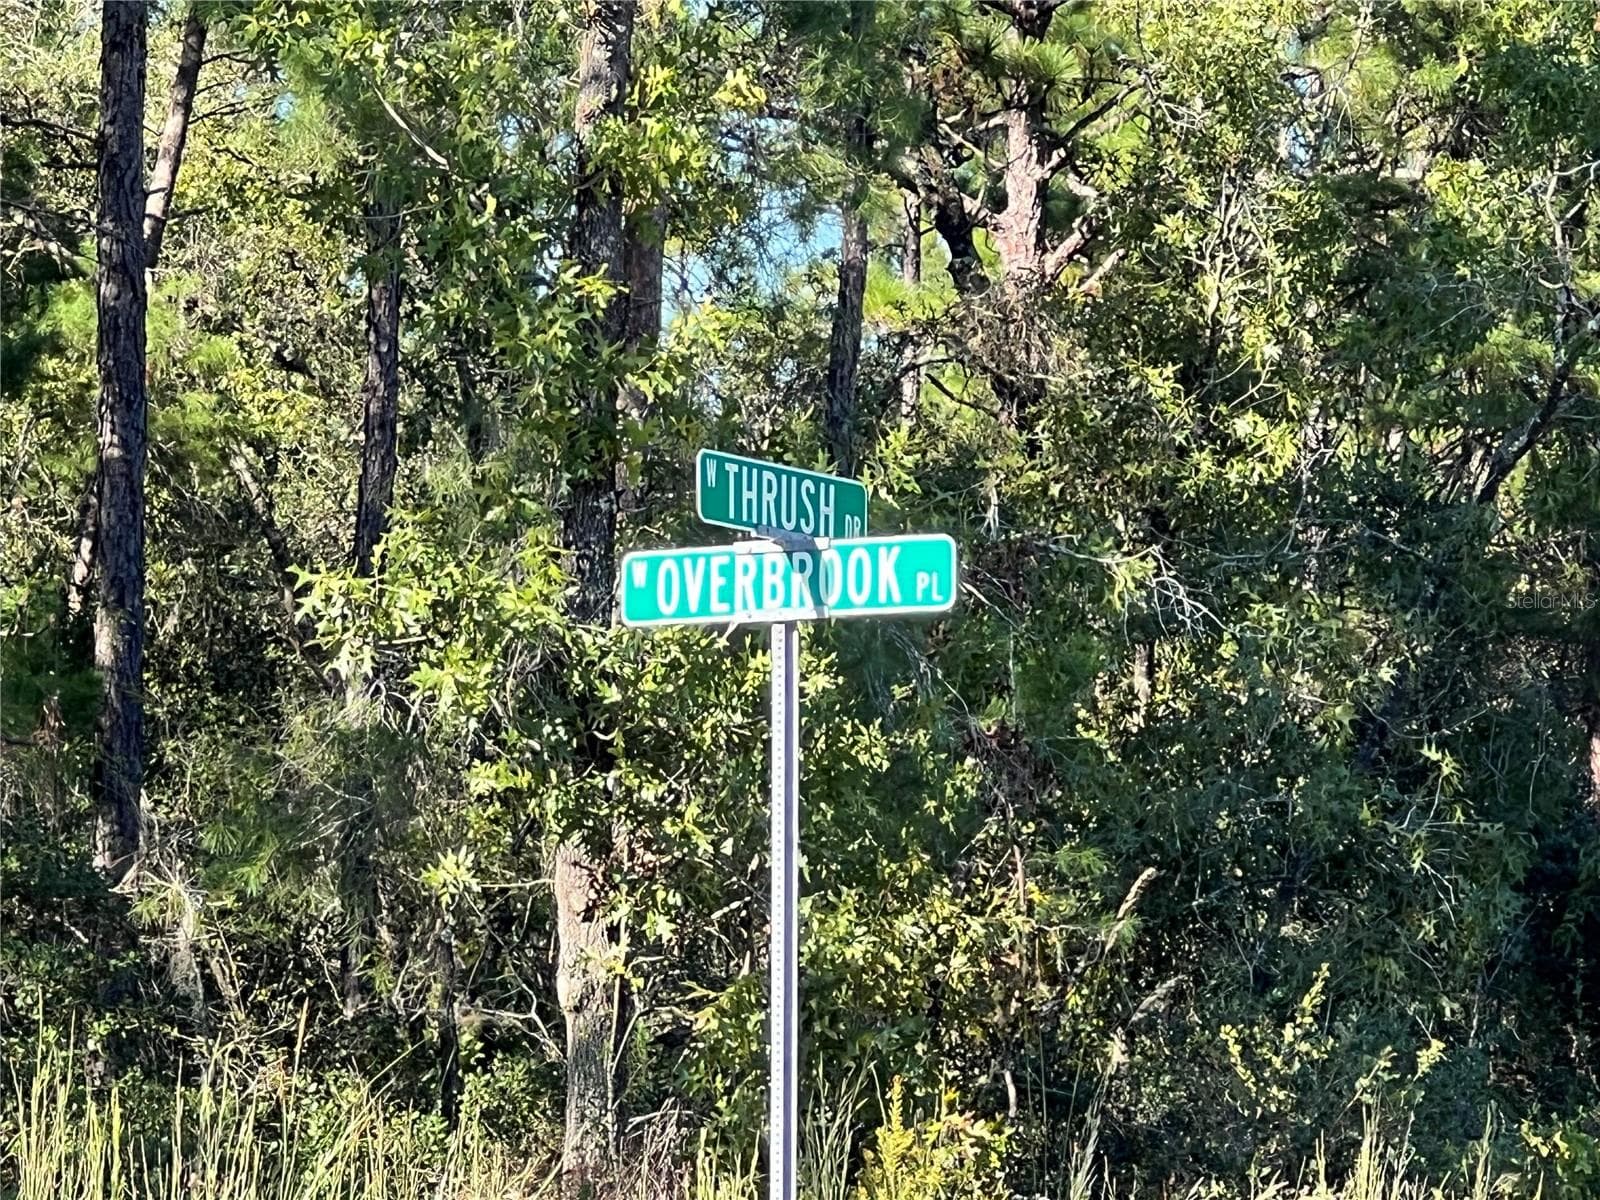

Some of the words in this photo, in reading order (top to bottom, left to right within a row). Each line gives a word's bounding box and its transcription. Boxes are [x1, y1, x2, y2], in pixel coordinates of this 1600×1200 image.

[706, 458, 717, 488] W
[725, 462, 835, 538] THRUSH
[845, 514, 861, 539] DR
[632, 560, 647, 588] W
[657, 546, 901, 615] OVERBROOK
[915, 571, 943, 601] PL
